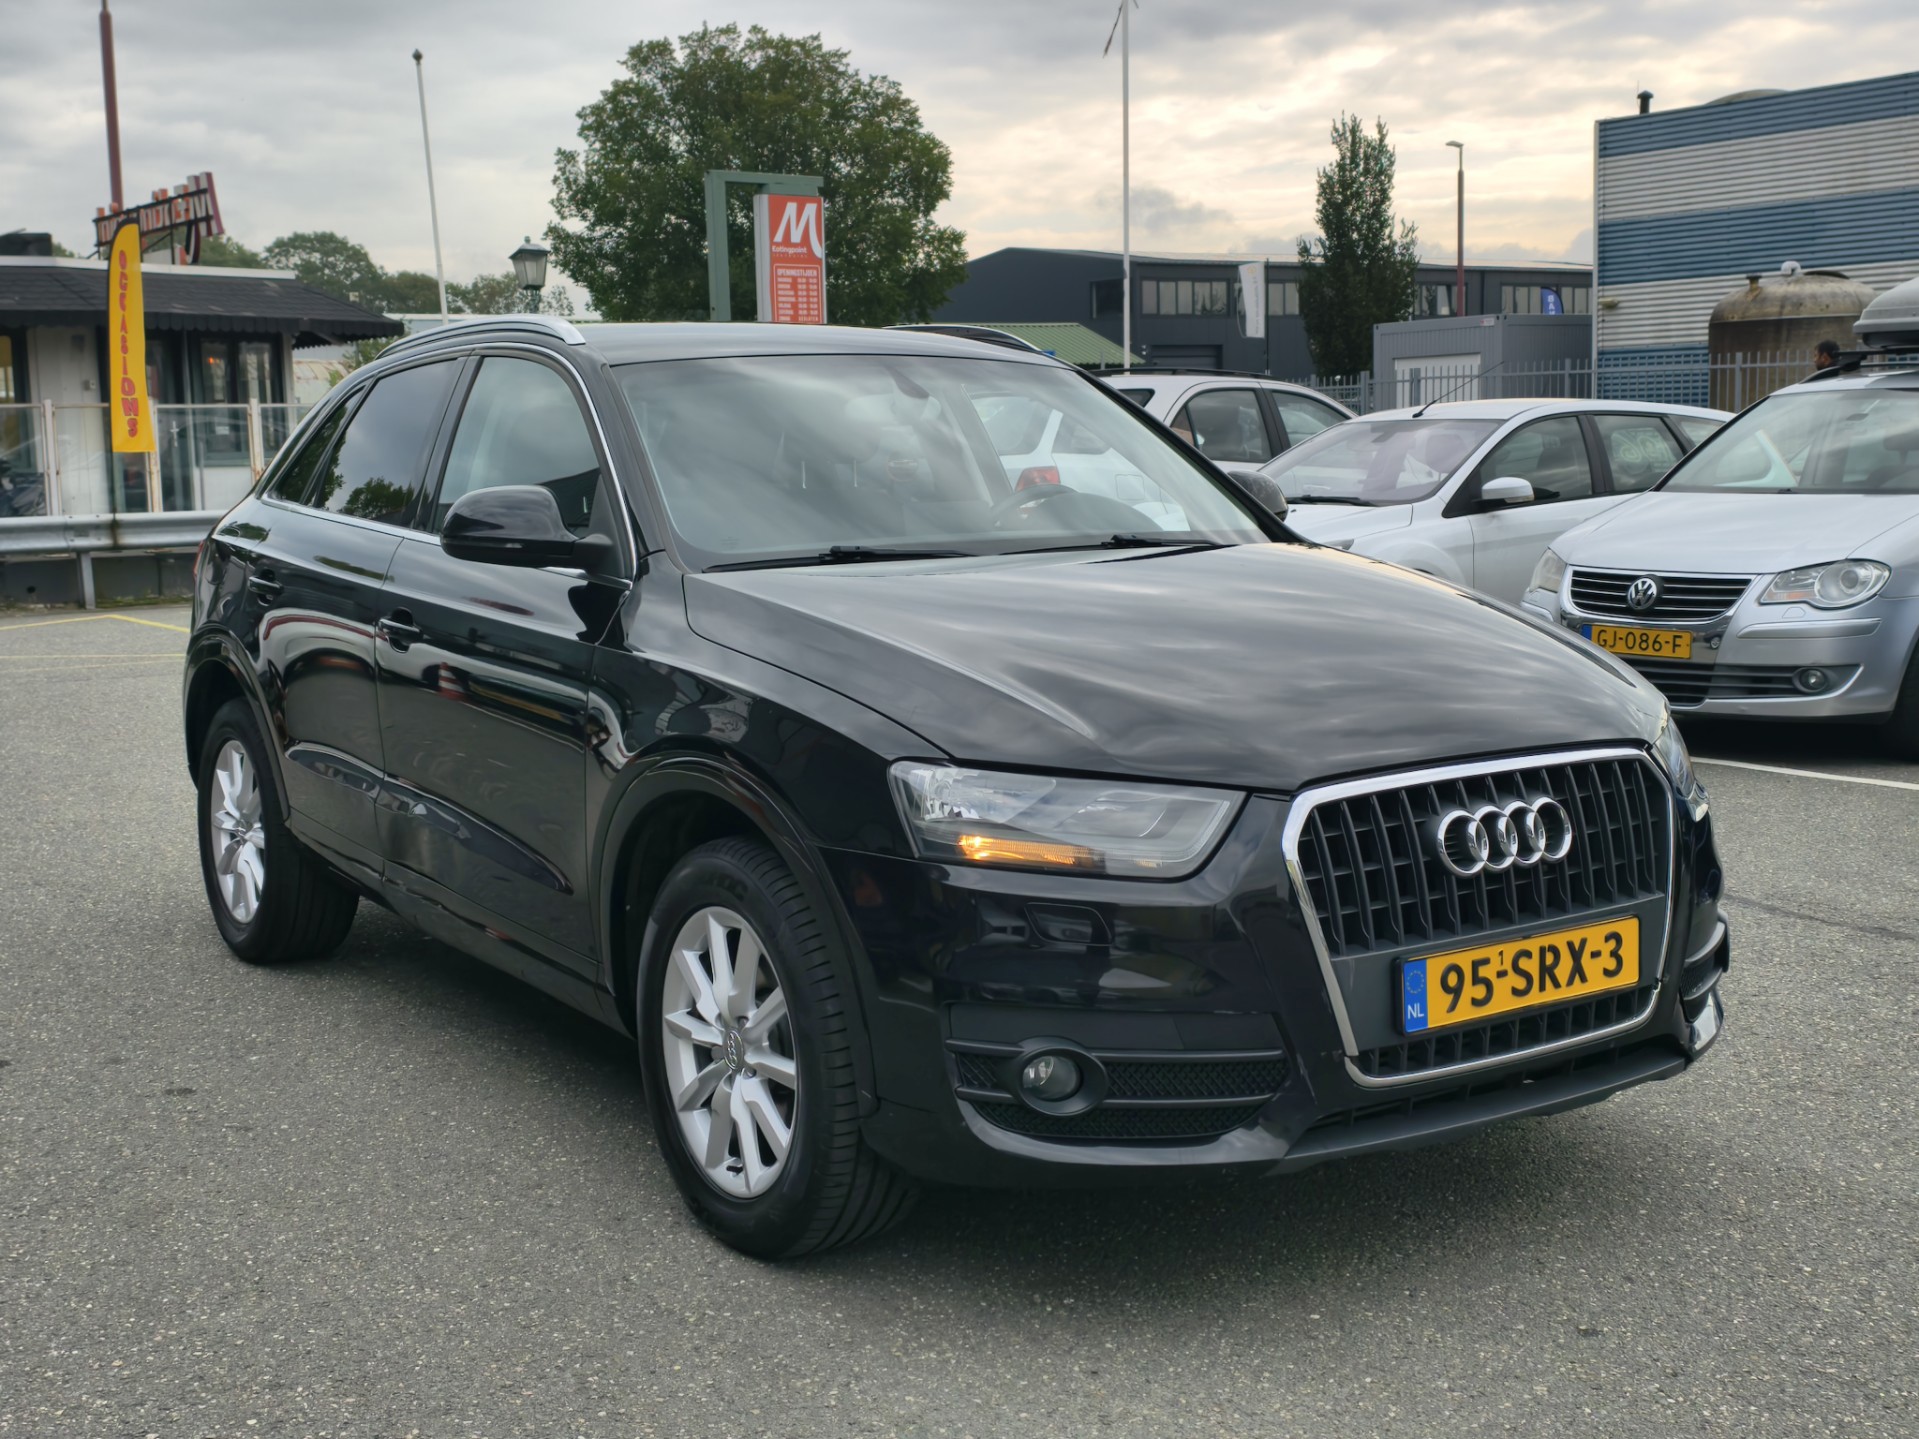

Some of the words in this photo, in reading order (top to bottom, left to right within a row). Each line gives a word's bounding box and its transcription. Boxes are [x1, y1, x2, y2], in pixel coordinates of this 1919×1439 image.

[773, 202, 822, 259] M
[118, 249, 140, 438] OCCASIONS
[1597, 629, 1683, 654] GJ-086-F
[1440, 930, 1625, 1014] 95-SRX-3
[1407, 1002, 1425, 1020] NL
